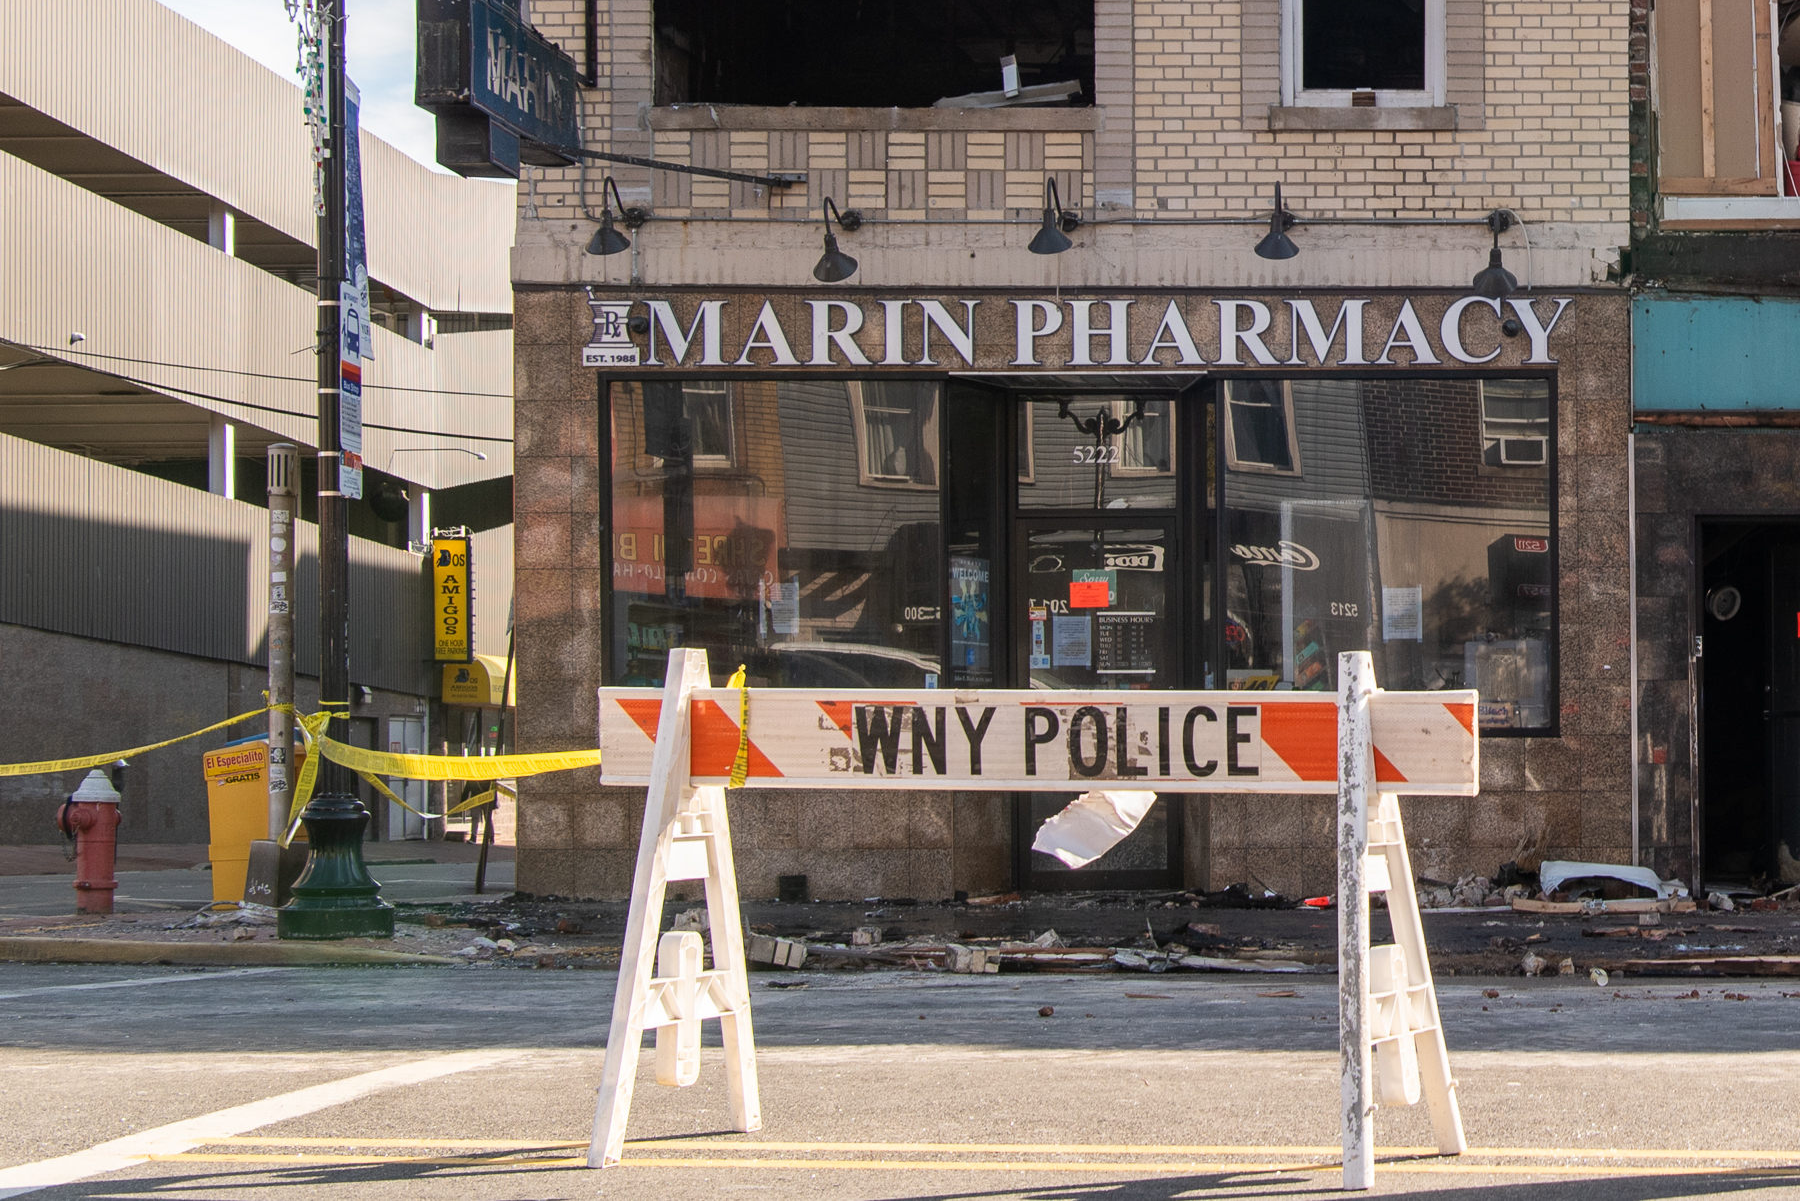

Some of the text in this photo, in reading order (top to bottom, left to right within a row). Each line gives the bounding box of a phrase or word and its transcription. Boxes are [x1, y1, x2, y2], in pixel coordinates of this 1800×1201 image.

[487, 26, 563, 130] MARIN
[641, 296, 1574, 367] MARIN PHARMACY
[586, 354, 636, 363] EST. 1988
[1072, 445, 1120, 464] 5222
[952, 567, 990, 583] WELCOME
[441, 574, 460, 635] AMIGOS
[436, 647, 467, 655] FREE PARKING
[450, 639, 463, 647] HOUR
[854, 705, 1260, 777] WNY POLICE
[206, 757, 214, 769] El
[217, 750, 263, 768] Especialito
[225, 772, 260, 784] GRATIS
